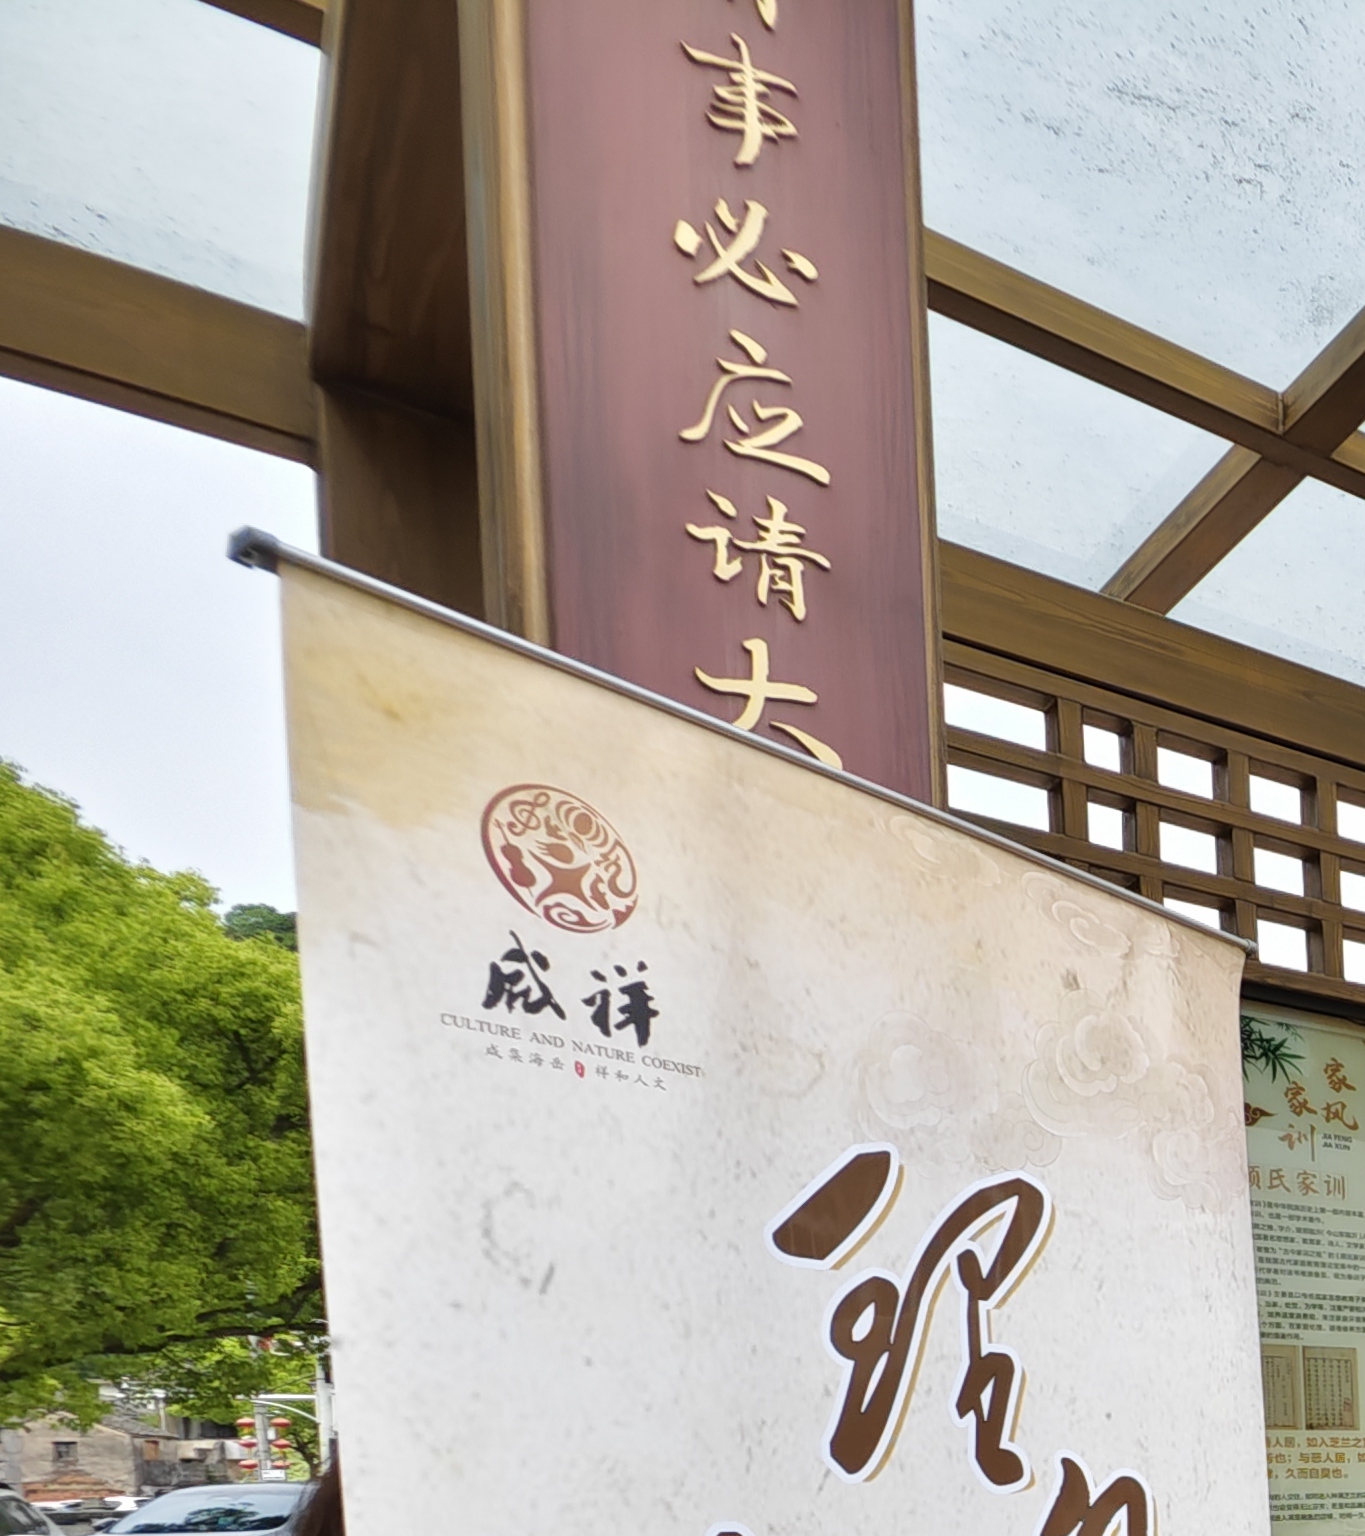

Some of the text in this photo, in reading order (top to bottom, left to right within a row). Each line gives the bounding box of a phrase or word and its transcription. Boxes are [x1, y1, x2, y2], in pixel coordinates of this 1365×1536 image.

[672, 0, 843, 770] 事必应请大
[440, 1012, 702, 1078] CULTURE AND NATURE COEXIST
[1278, 1080, 1318, 1163] 家训
[1323, 1057, 1359, 1131] 家风
